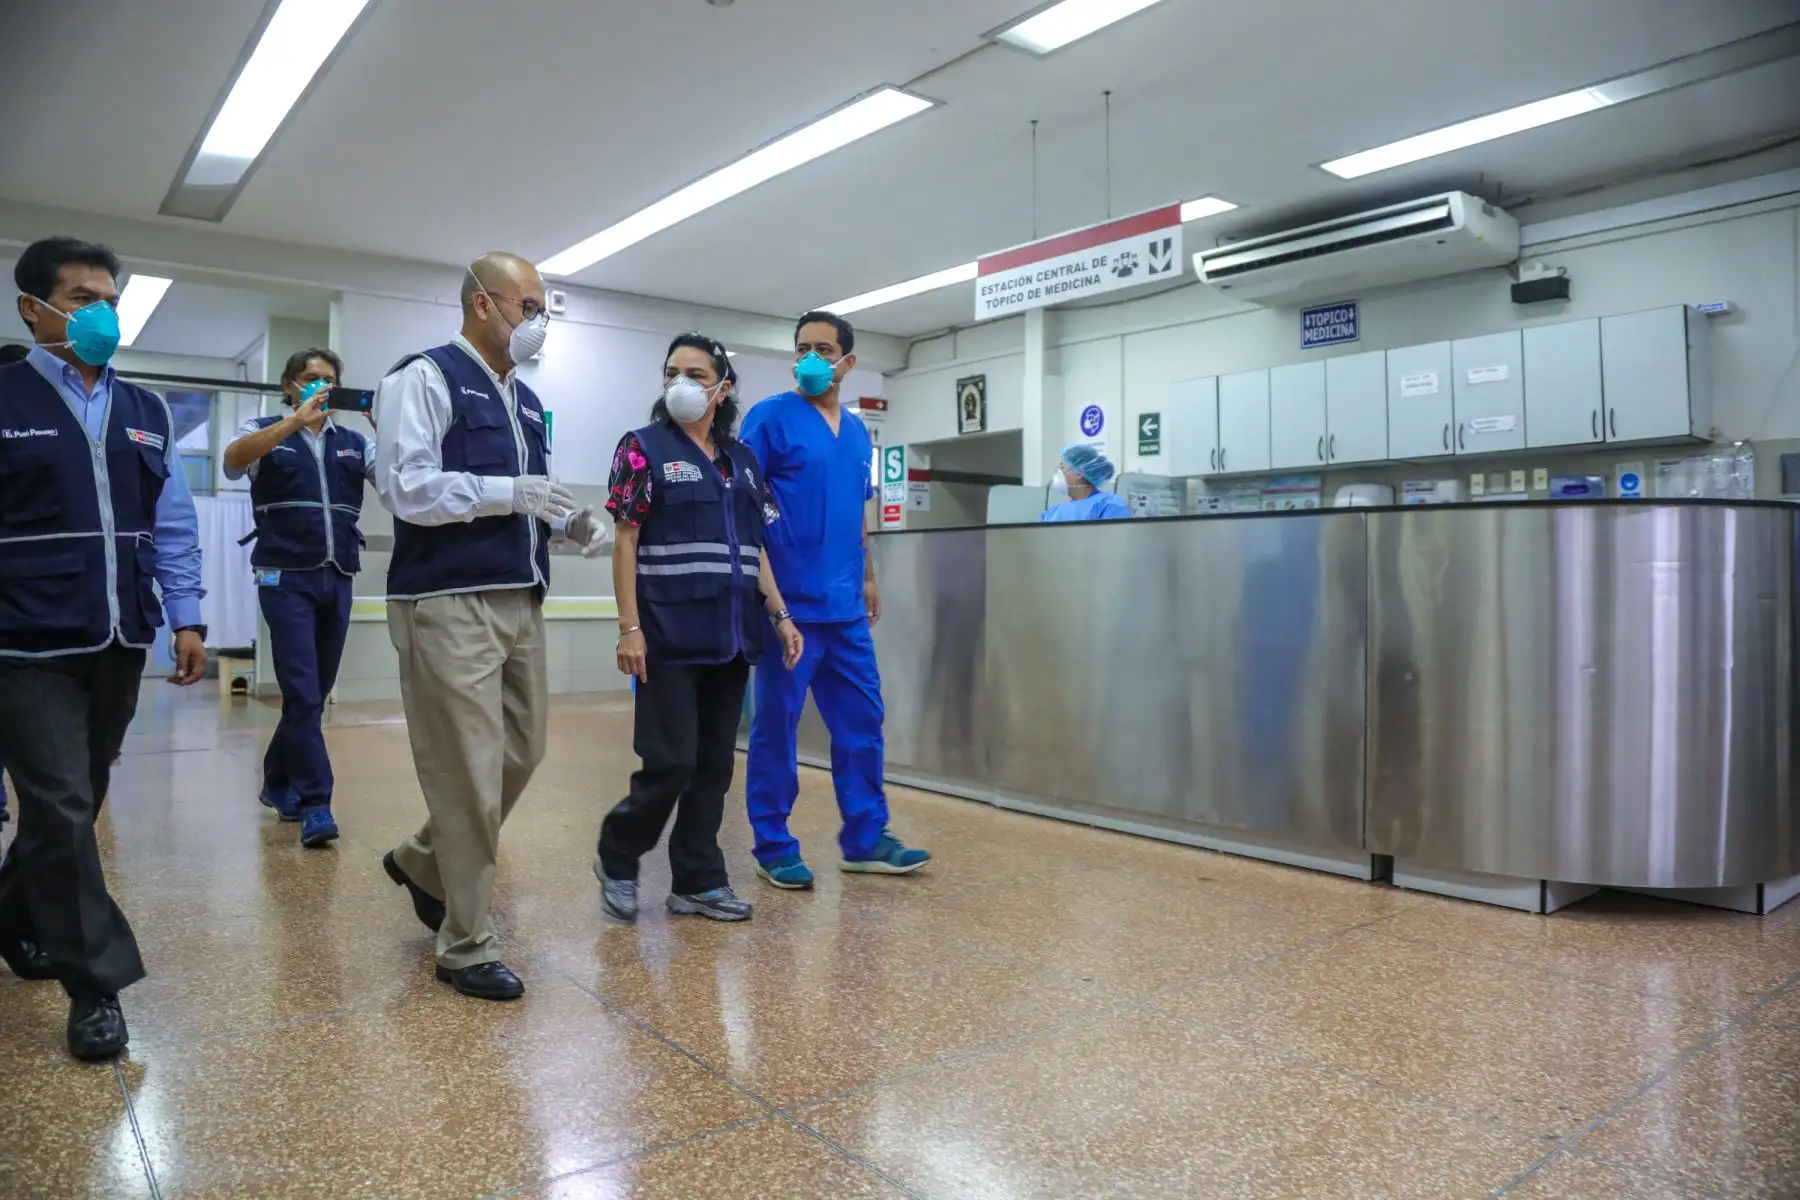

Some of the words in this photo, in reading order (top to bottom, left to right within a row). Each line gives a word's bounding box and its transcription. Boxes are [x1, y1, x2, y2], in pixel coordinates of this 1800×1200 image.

[1036, 261, 1088, 283] CENTRAL
[1092, 255, 1108, 269] DE
[1028, 287, 1042, 300] DE
[1045, 274, 1101, 296] MEDICINA
[1310, 309, 1348, 327] TOPICO
[1304, 322, 1356, 342] MEDICINA
[887, 449, 902, 480] S
